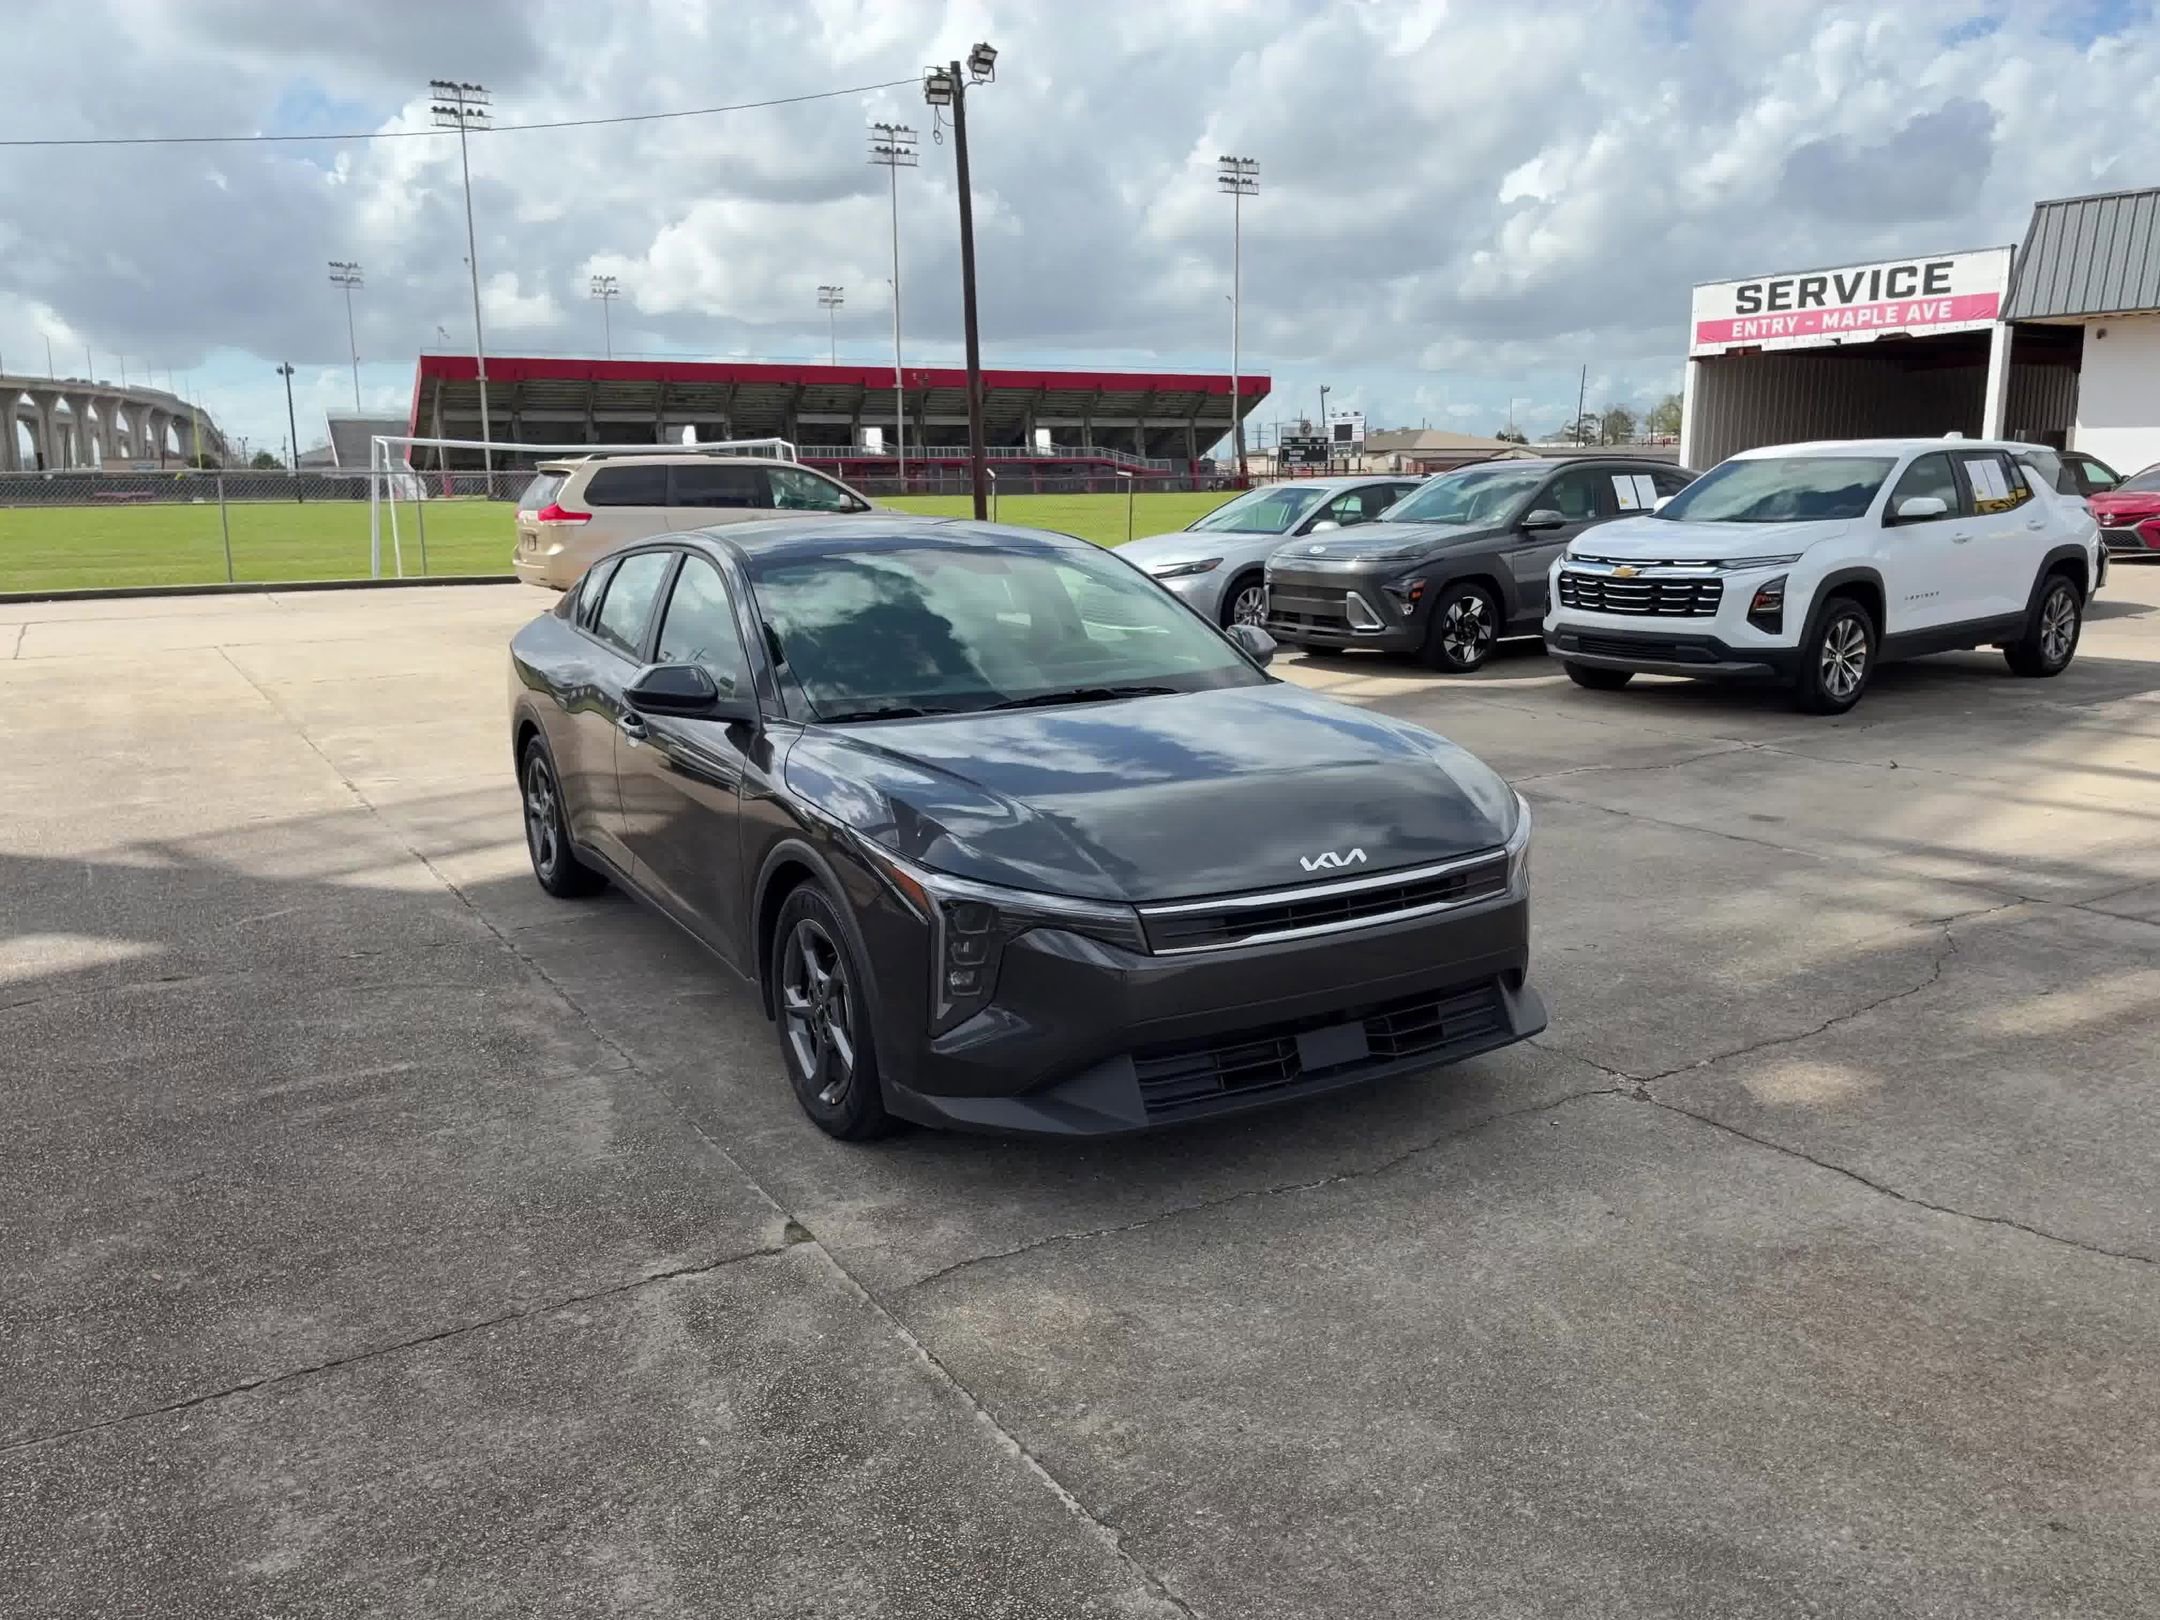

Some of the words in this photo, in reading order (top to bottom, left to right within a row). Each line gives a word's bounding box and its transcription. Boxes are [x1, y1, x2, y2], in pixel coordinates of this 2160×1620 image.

[1736, 261, 1954, 315] SERVICE
[1731, 315, 1799, 338] ENTRY
[1822, 305, 1899, 330] MAPLE
[1905, 300, 1953, 323] AVE
[1300, 848, 1367, 872] KIA
